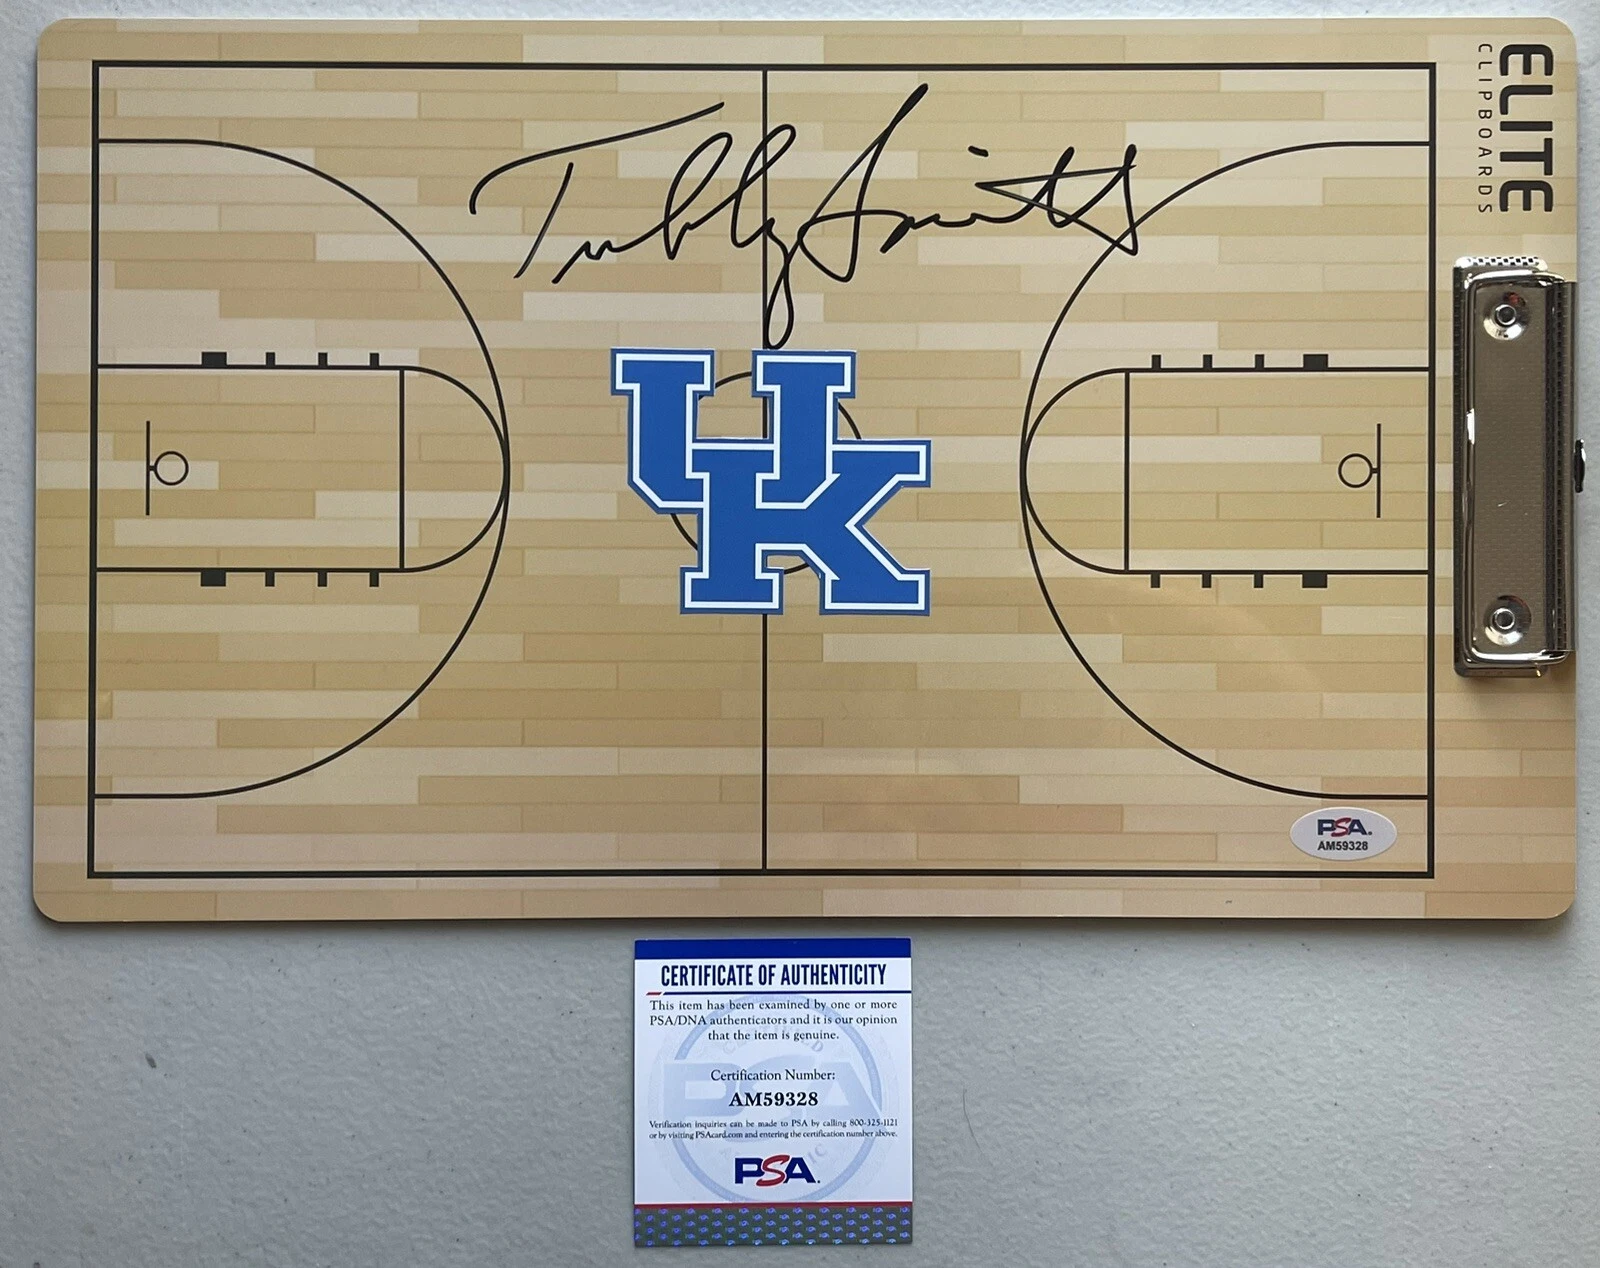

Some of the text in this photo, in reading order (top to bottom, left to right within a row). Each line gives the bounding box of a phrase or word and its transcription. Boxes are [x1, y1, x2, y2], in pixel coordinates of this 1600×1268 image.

[1478, 43, 1493, 213] CLIPBOARDS
[1499, 44, 1554, 212] ELITE
[610, 347, 931, 617] UK
[1317, 841, 1368, 851] AM59328
[661, 963, 887, 987] CERTIFICATE OF AUTHENTICITY
[649, 998, 898, 1012] This item has been examined by one or more
[649, 1014, 898, 1027] PSA/DNA authenticators and it is our opinion
[707, 1030, 840, 1043] that the item is genuine.
[710, 1069, 836, 1081] Certification Number:
[728, 1091, 819, 1108] AM59328
[649, 1120, 692, 1129] Verification
[695, 1120, 727, 1130] inquiries
[745, 1119, 755, 1128] be
[758, 1119, 778, 1128] made
[780, 1120, 789, 1128] to
[791, 1119, 808, 1128] PSA
[811, 1119, 820, 1129] by
[822, 1118, 847, 1129] calling
[849, 1118, 898, 1127] 800-325-1121
[658, 1131, 667, 1141] by
[668, 1131, 694, 1141] visiting
[695, 1130, 743, 1139] PSAcard.com
[744, 1130, 758, 1139] and
[759, 1130, 789, 1140] entering
[790, 1130, 802, 1138] the
[802, 1130, 845, 1138] certification
[845, 1129, 874, 1138] number
[875, 1129, 898, 1138] above.
